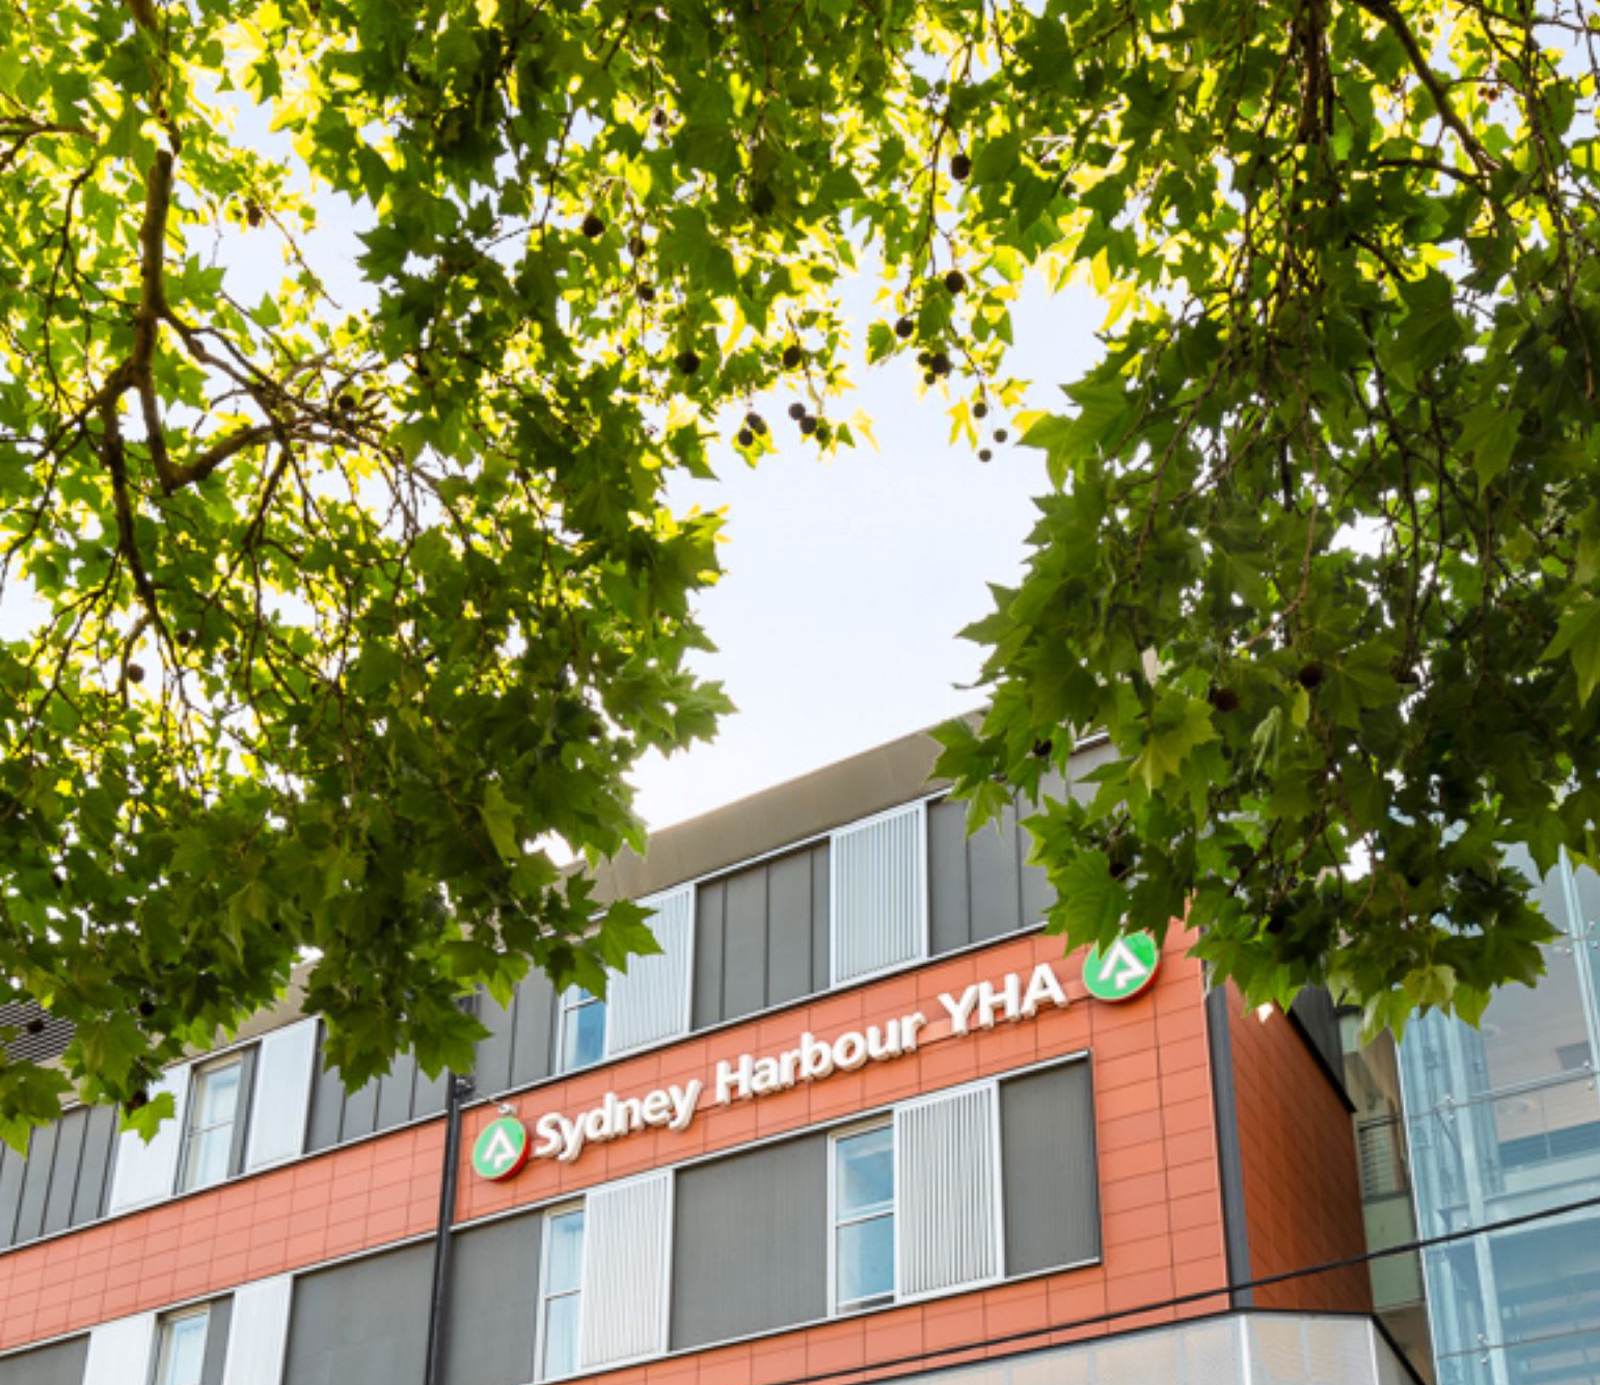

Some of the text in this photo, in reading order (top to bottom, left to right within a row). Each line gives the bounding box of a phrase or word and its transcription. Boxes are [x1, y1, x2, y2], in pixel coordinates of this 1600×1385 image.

[535, 962, 1068, 1163] Sydney Harbour YHA
